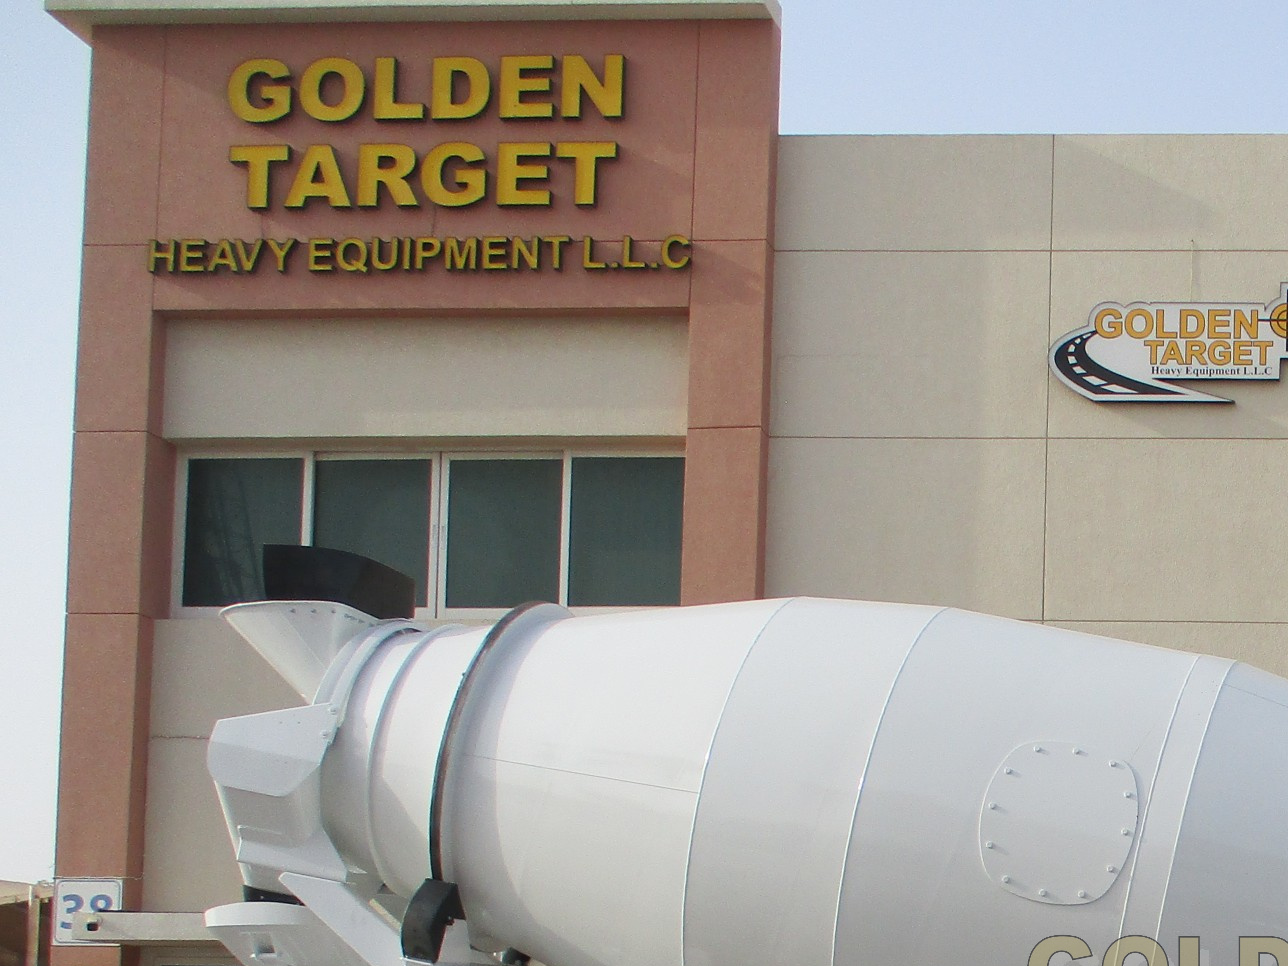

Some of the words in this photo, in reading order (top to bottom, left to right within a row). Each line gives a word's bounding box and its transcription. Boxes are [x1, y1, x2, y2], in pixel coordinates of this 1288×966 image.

[227, 54, 625, 123] GOLDEN
[229, 141, 618, 208] TARGET
[147, 237, 295, 273] HEAVY
[308, 234, 571, 273] EQUIPMENT
[582, 234, 691, 270] L.L.C
[1094, 308, 1259, 339] GOLDEN
[1144, 340, 1273, 366] TARGET
[1151, 366, 1183, 377] Heavy
[1185, 366, 1241, 377] Equipment
[1243, 366, 1273, 376] L.L.C
